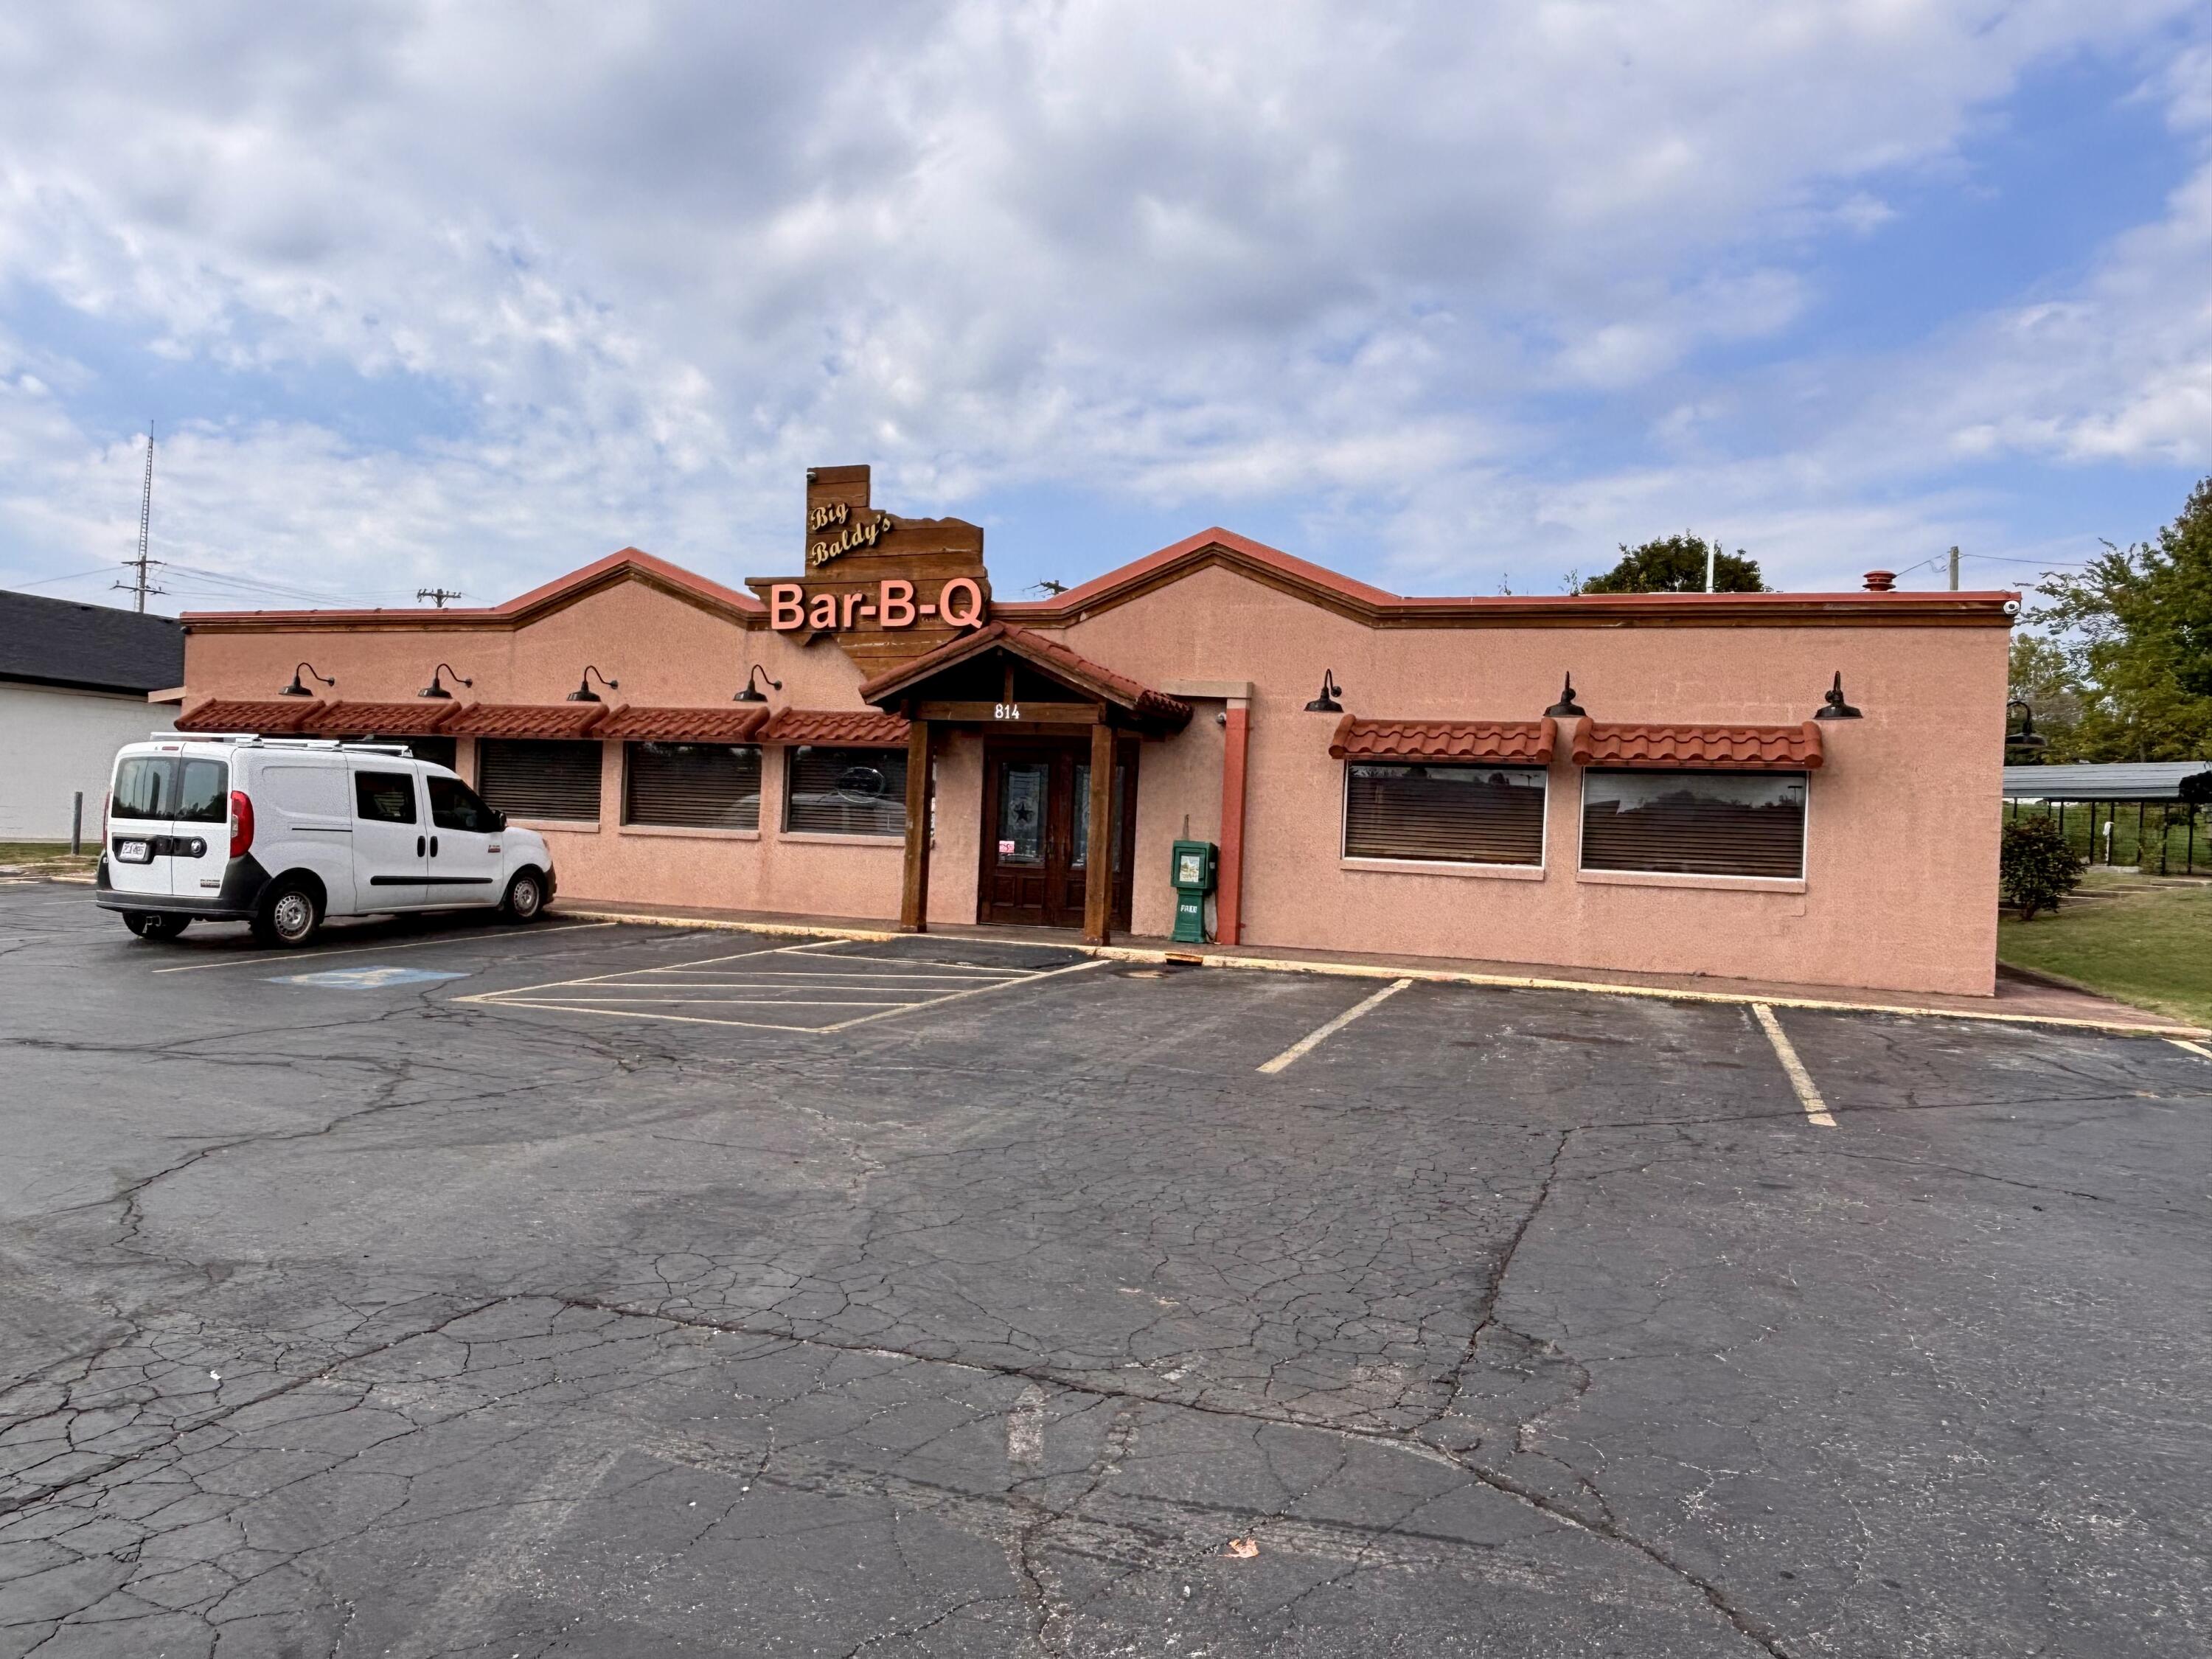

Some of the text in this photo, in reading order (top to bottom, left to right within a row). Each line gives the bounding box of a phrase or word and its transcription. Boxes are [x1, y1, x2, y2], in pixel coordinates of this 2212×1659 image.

[811, 503, 849, 530] Big
[812, 515, 891, 566] Baldy's
[771, 578, 983, 630] Bar-B-Q
[995, 703, 1020, 720] 814
[1180, 905, 1197, 913] FREE
